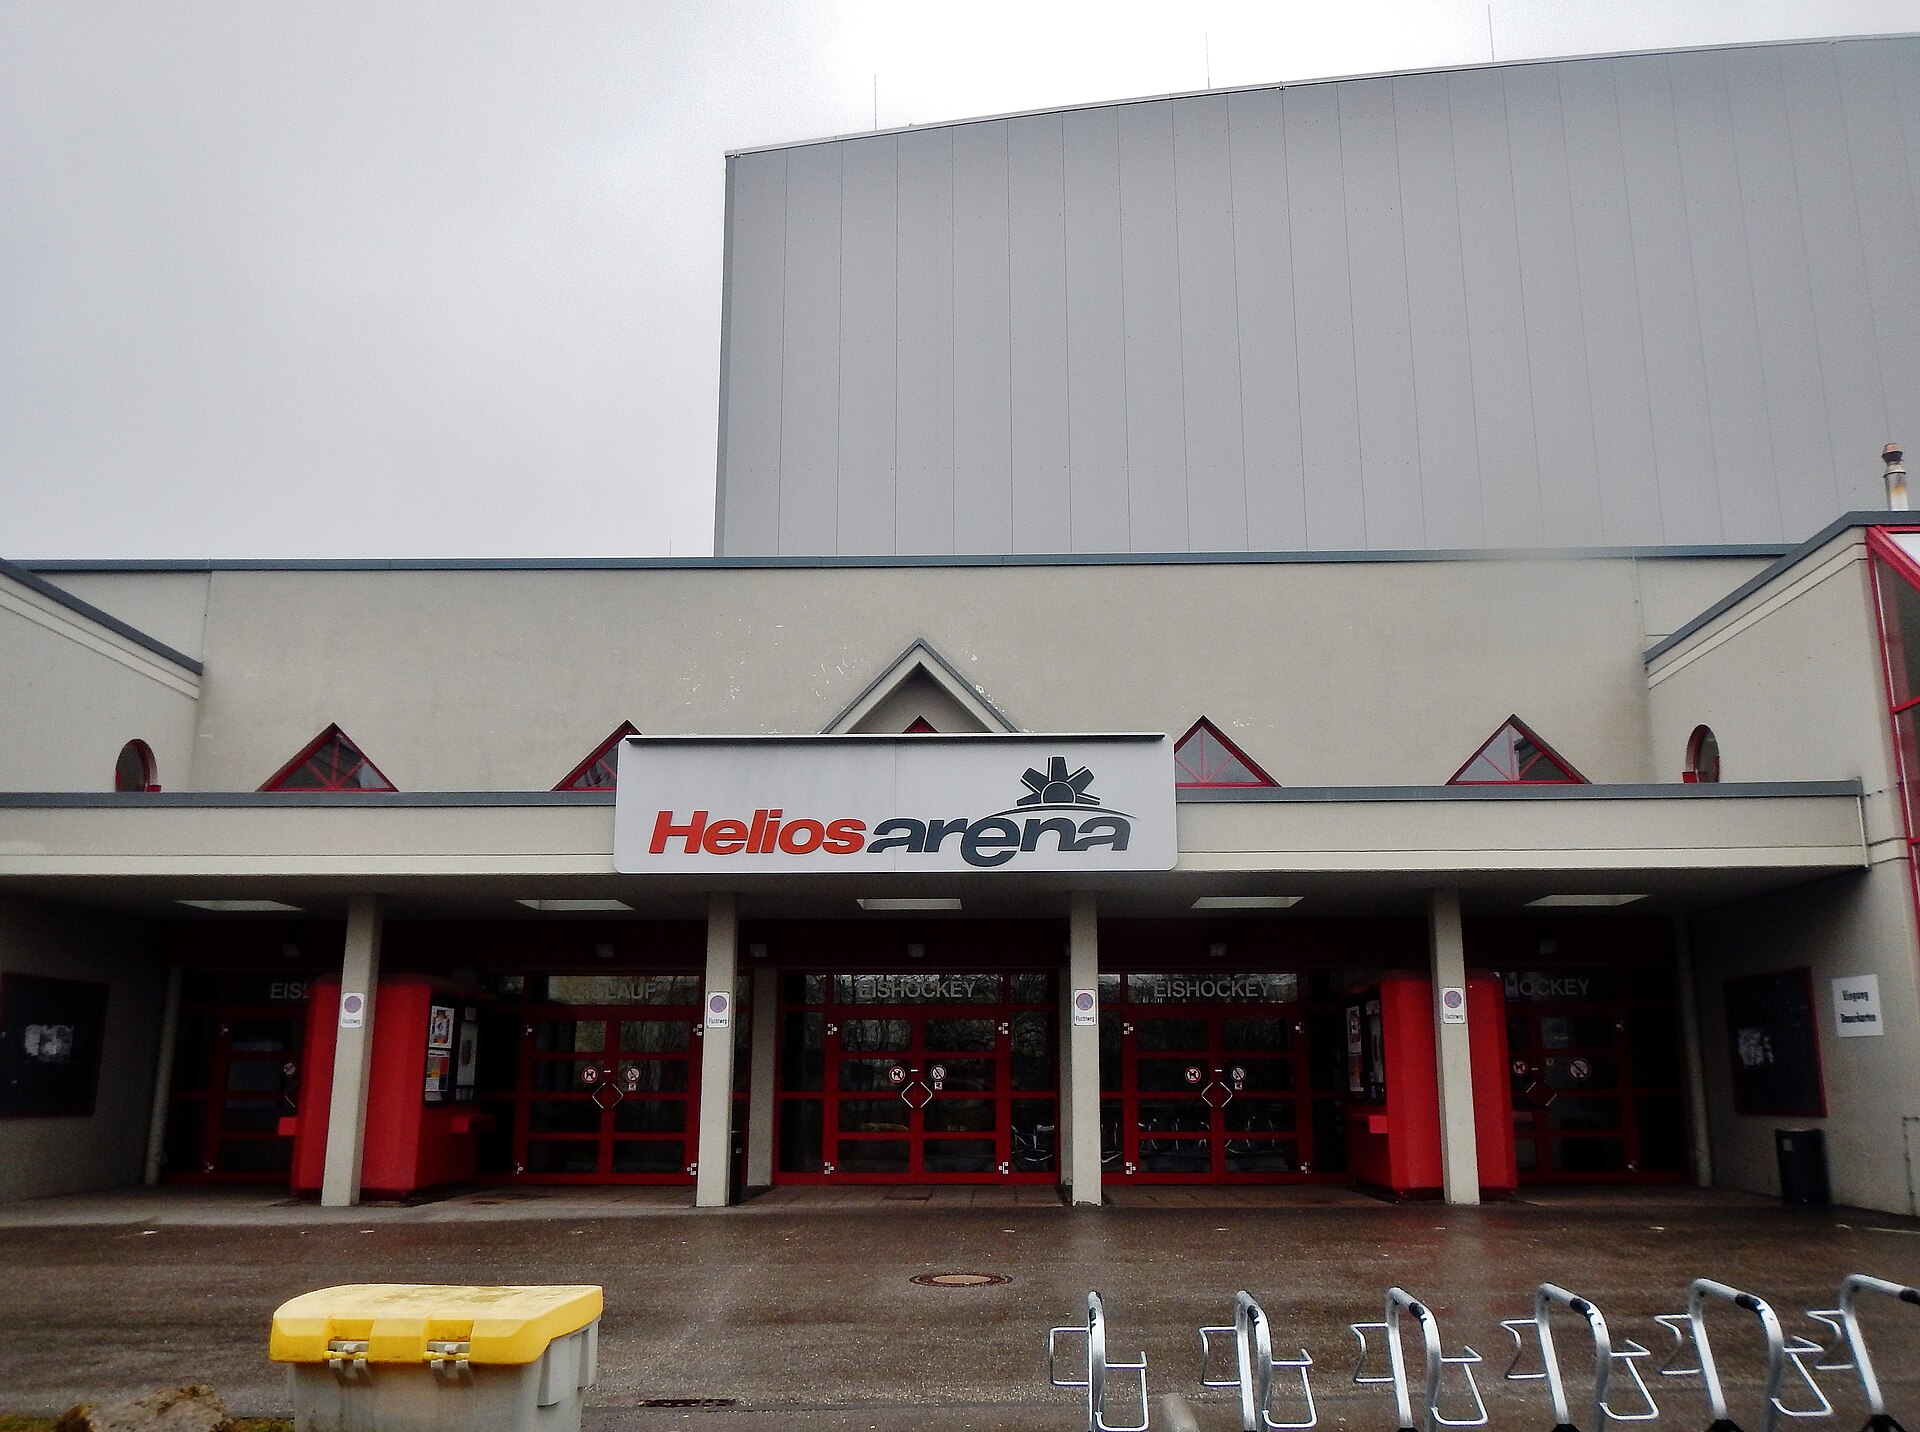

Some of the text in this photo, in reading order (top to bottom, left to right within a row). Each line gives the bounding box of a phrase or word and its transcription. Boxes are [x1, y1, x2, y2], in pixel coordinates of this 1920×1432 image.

[859, 979, 978, 999] EISHOCKEY
[1153, 979, 1270, 998] EISHOCKEY
[1504, 978, 1590, 996] HOCKEY
